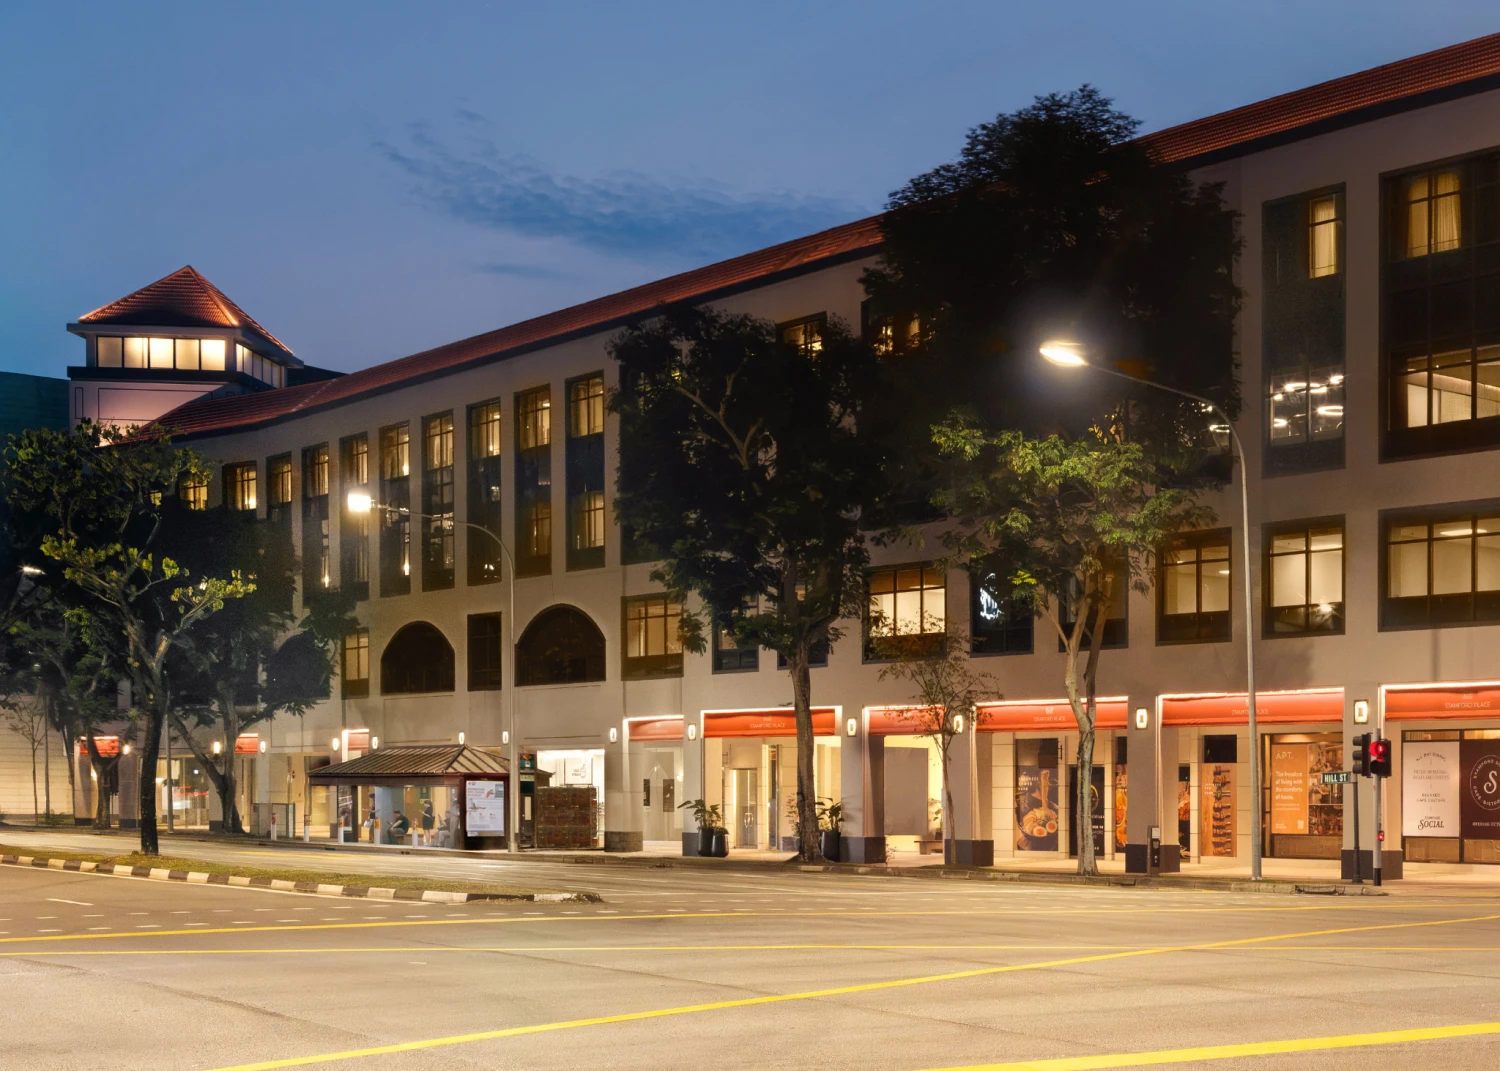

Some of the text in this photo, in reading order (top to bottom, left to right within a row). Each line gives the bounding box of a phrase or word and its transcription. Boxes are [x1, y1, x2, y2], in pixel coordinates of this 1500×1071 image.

[1473, 759, 1494, 779] STAMFORD
[1324, 773, 1347, 783] HILL ST
[1484, 770, 1498, 794] S
[1417, 819, 1445, 831] SOCIAL
